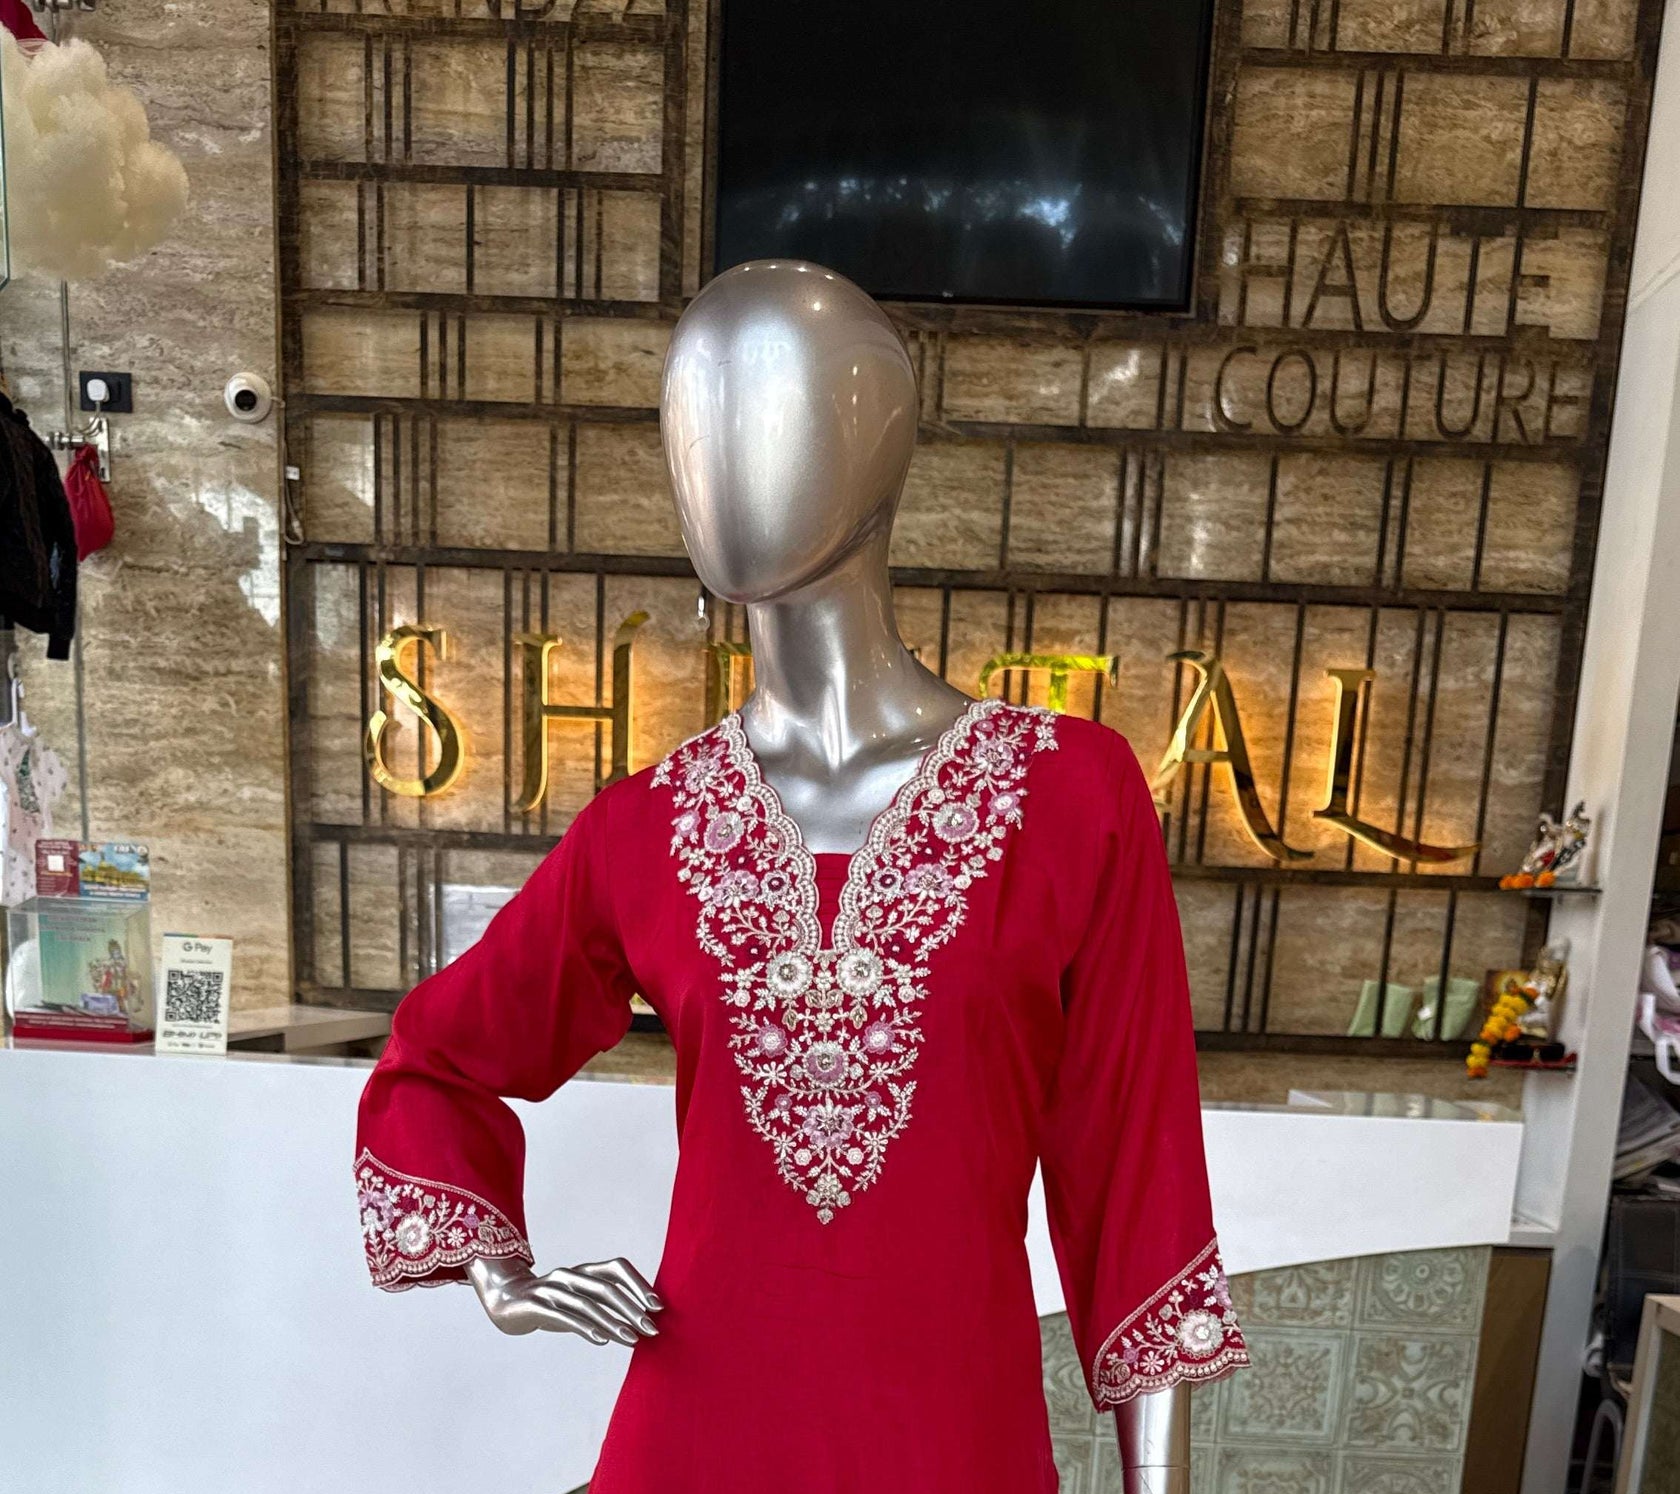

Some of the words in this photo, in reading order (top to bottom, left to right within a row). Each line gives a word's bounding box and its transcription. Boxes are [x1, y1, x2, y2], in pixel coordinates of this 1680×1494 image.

[1240, 211, 1560, 338] HAUTE
[1214, 345, 1584, 446] COUTURE
[365, 610, 1481, 864] SHTAL
[195, 943, 213, 955] Pay
